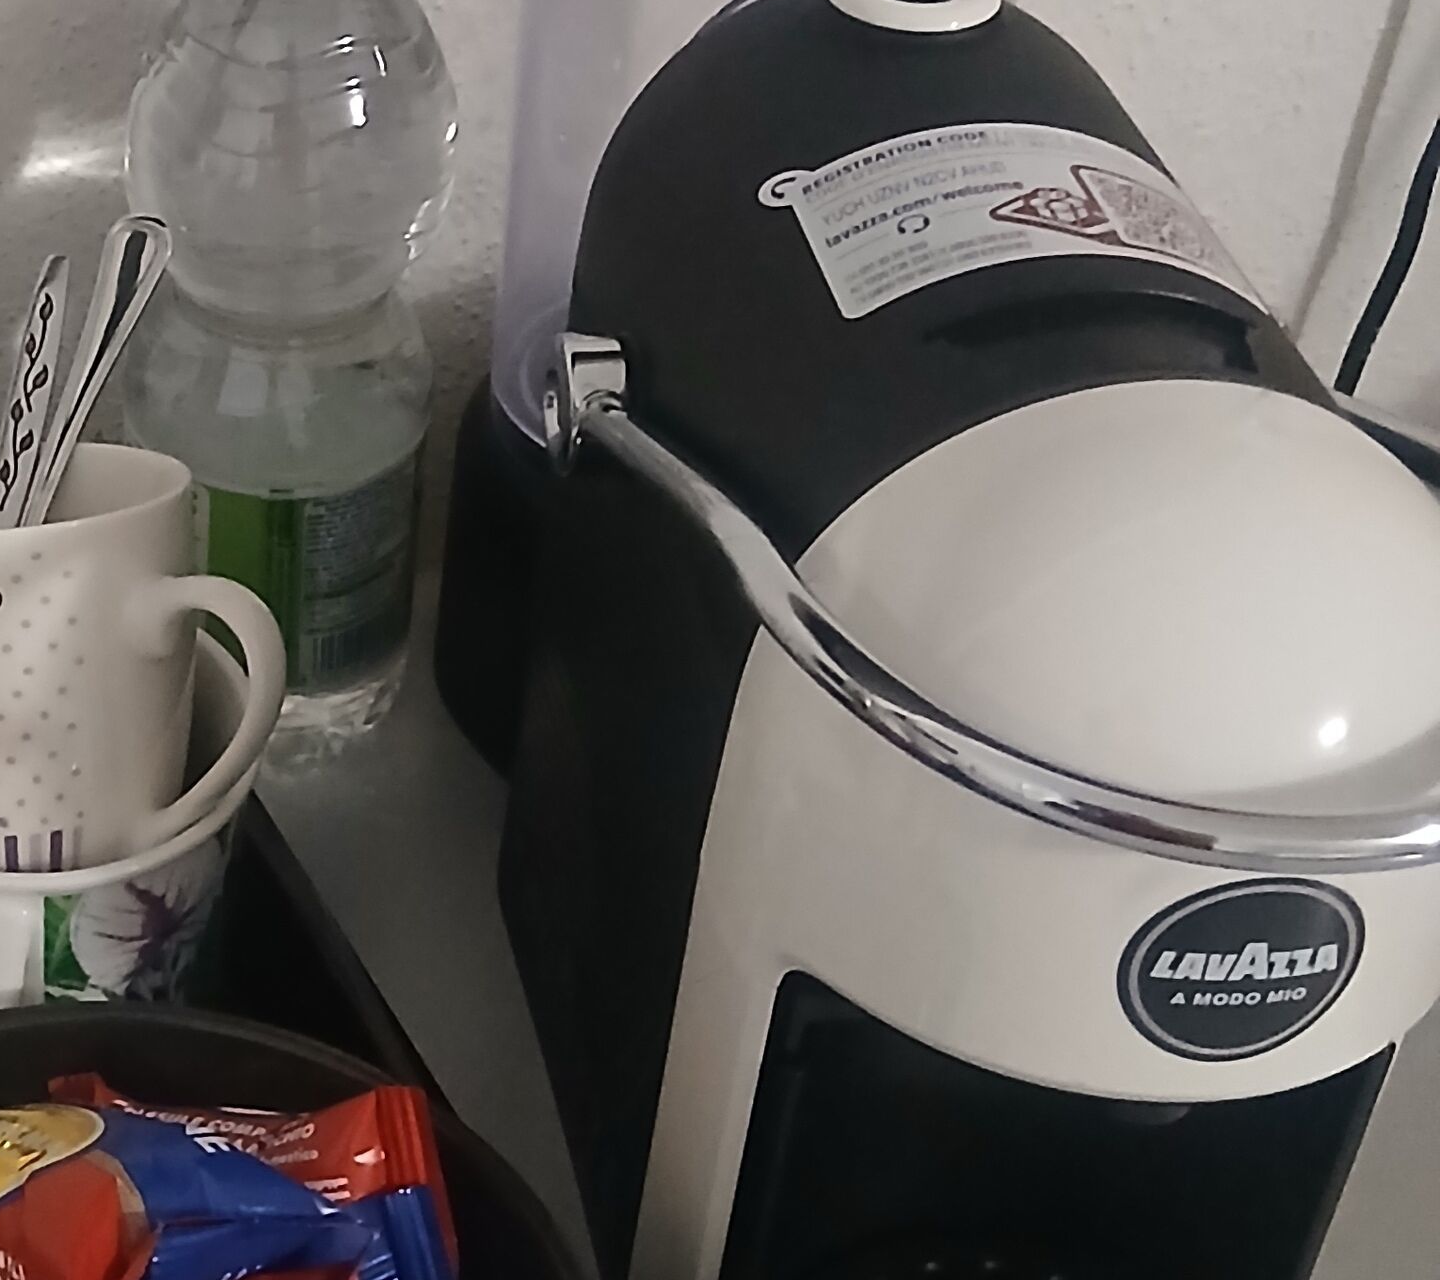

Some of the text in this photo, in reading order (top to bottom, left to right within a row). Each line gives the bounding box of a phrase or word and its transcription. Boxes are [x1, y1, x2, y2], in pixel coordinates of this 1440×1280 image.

[801, 139, 932, 196] REGISTRATION
[936, 130, 987, 144] CODE
[1149, 942, 1339, 982] LAVAZZA
[1170, 986, 1307, 1006] A MODO MIO
